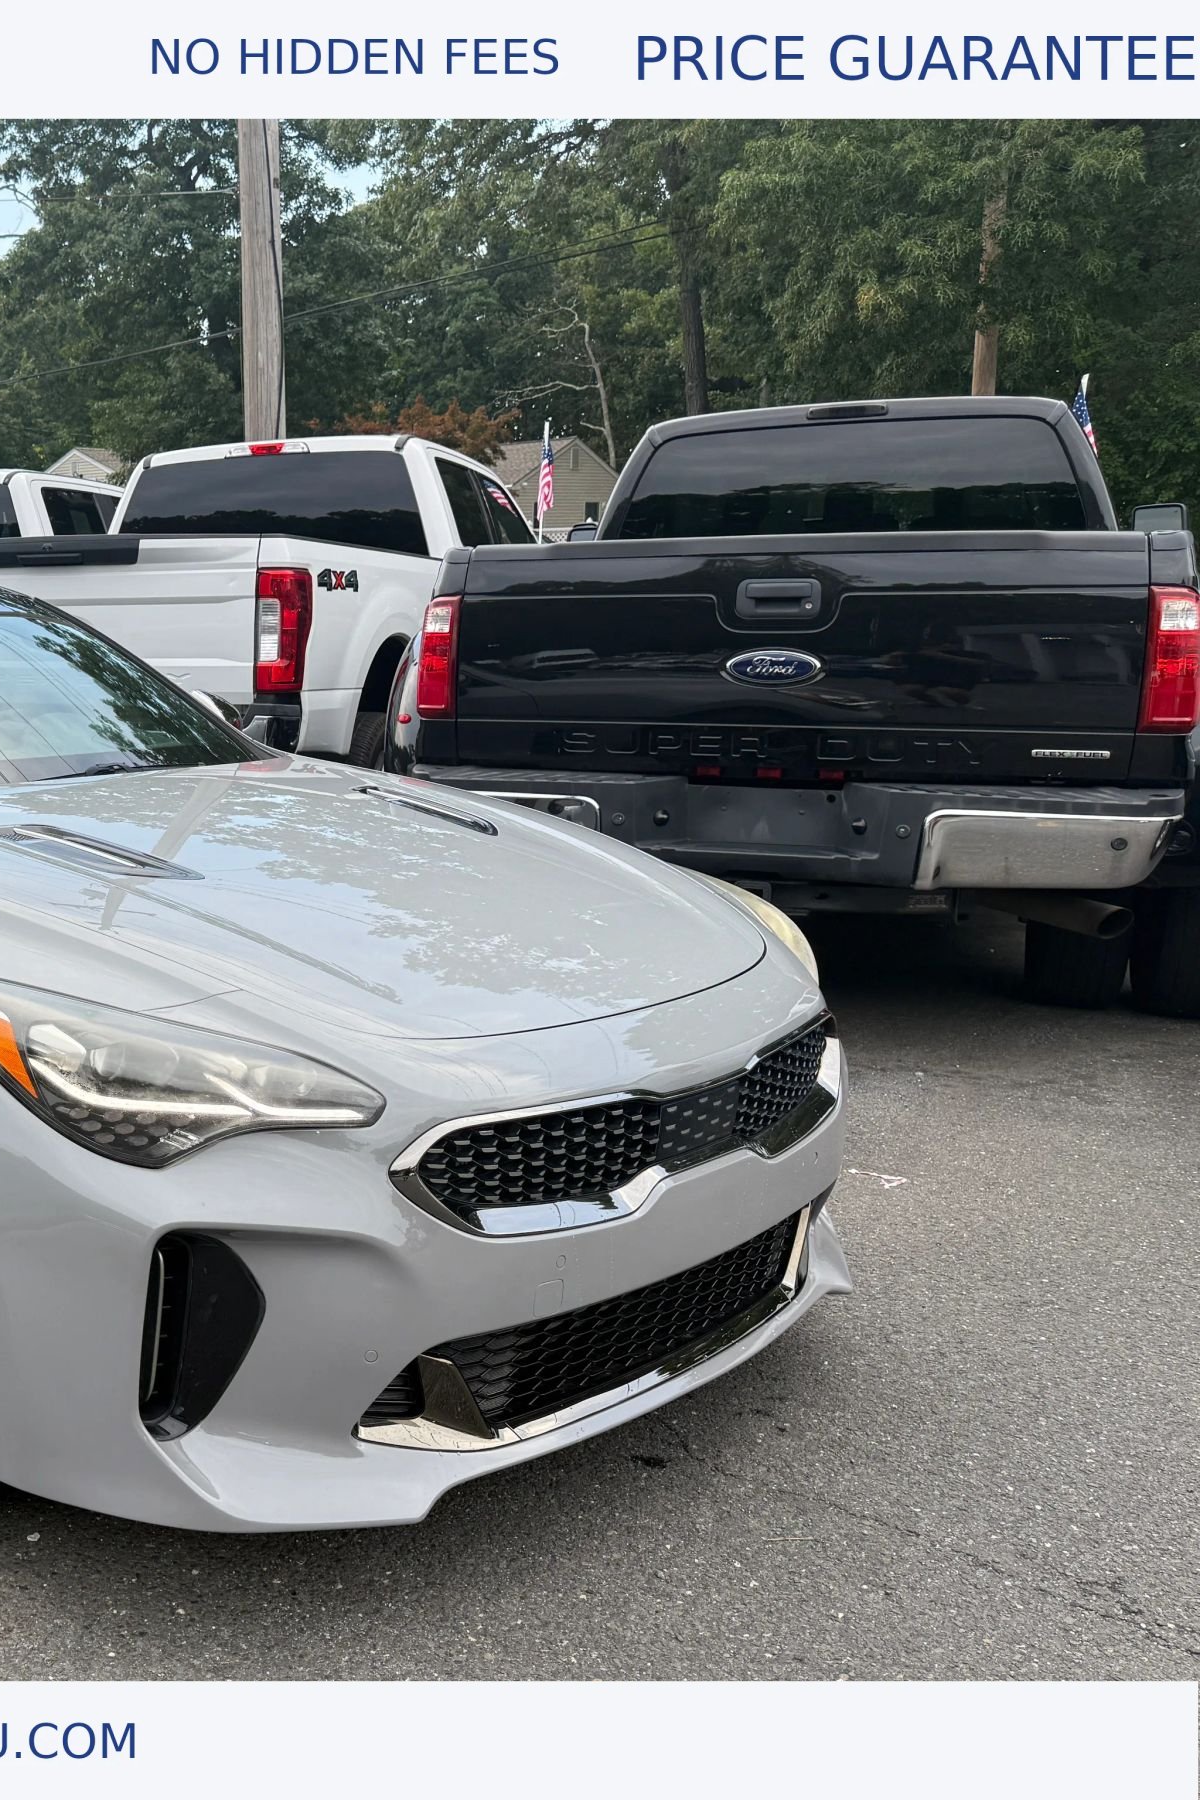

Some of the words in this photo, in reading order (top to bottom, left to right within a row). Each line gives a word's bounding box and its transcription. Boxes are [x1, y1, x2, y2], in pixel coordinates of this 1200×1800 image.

[747, 655, 798, 676] Ford
[560, 731, 768, 758] SUPER
[816, 734, 988, 765] DUTY
